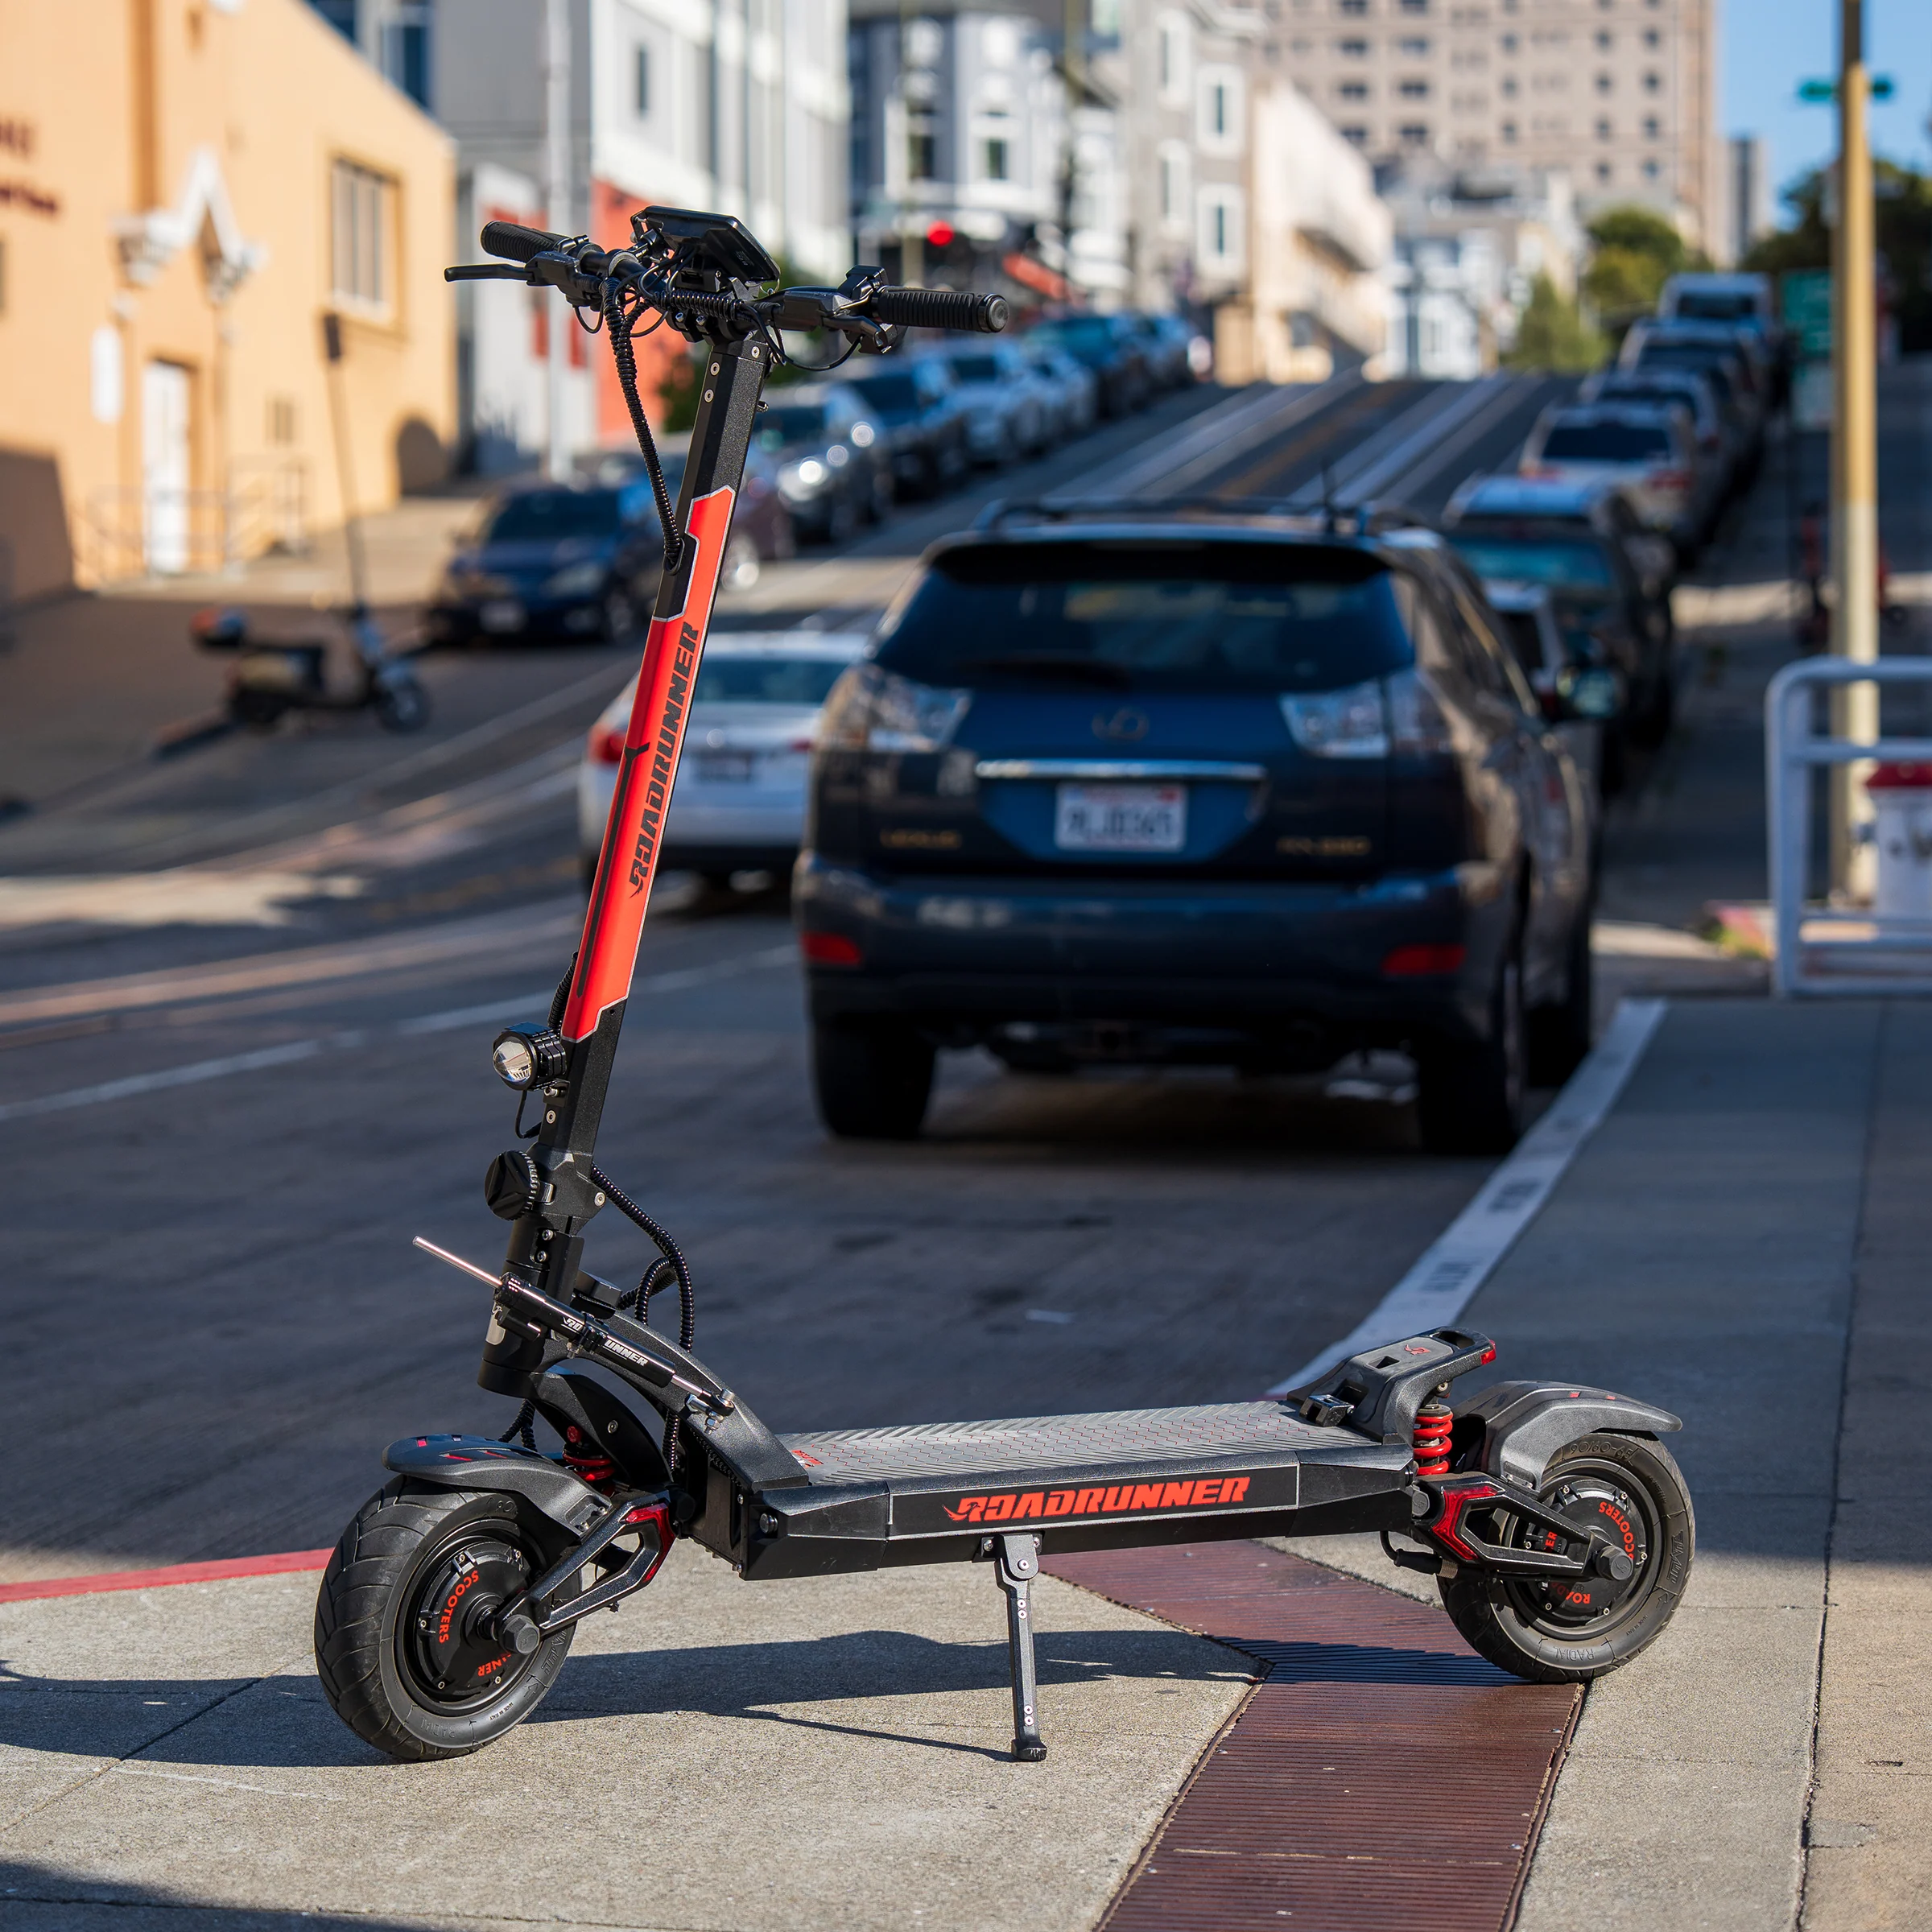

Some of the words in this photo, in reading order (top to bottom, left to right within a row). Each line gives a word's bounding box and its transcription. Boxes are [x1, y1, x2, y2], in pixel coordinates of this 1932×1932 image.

[629, 621, 699, 899] ROADRUNNER
[942, 1476, 1251, 1522] ROADRUNNER
[439, 1570, 479, 1644] SCOOTERS
[1554, 1645, 1595, 1661] RADIAL
